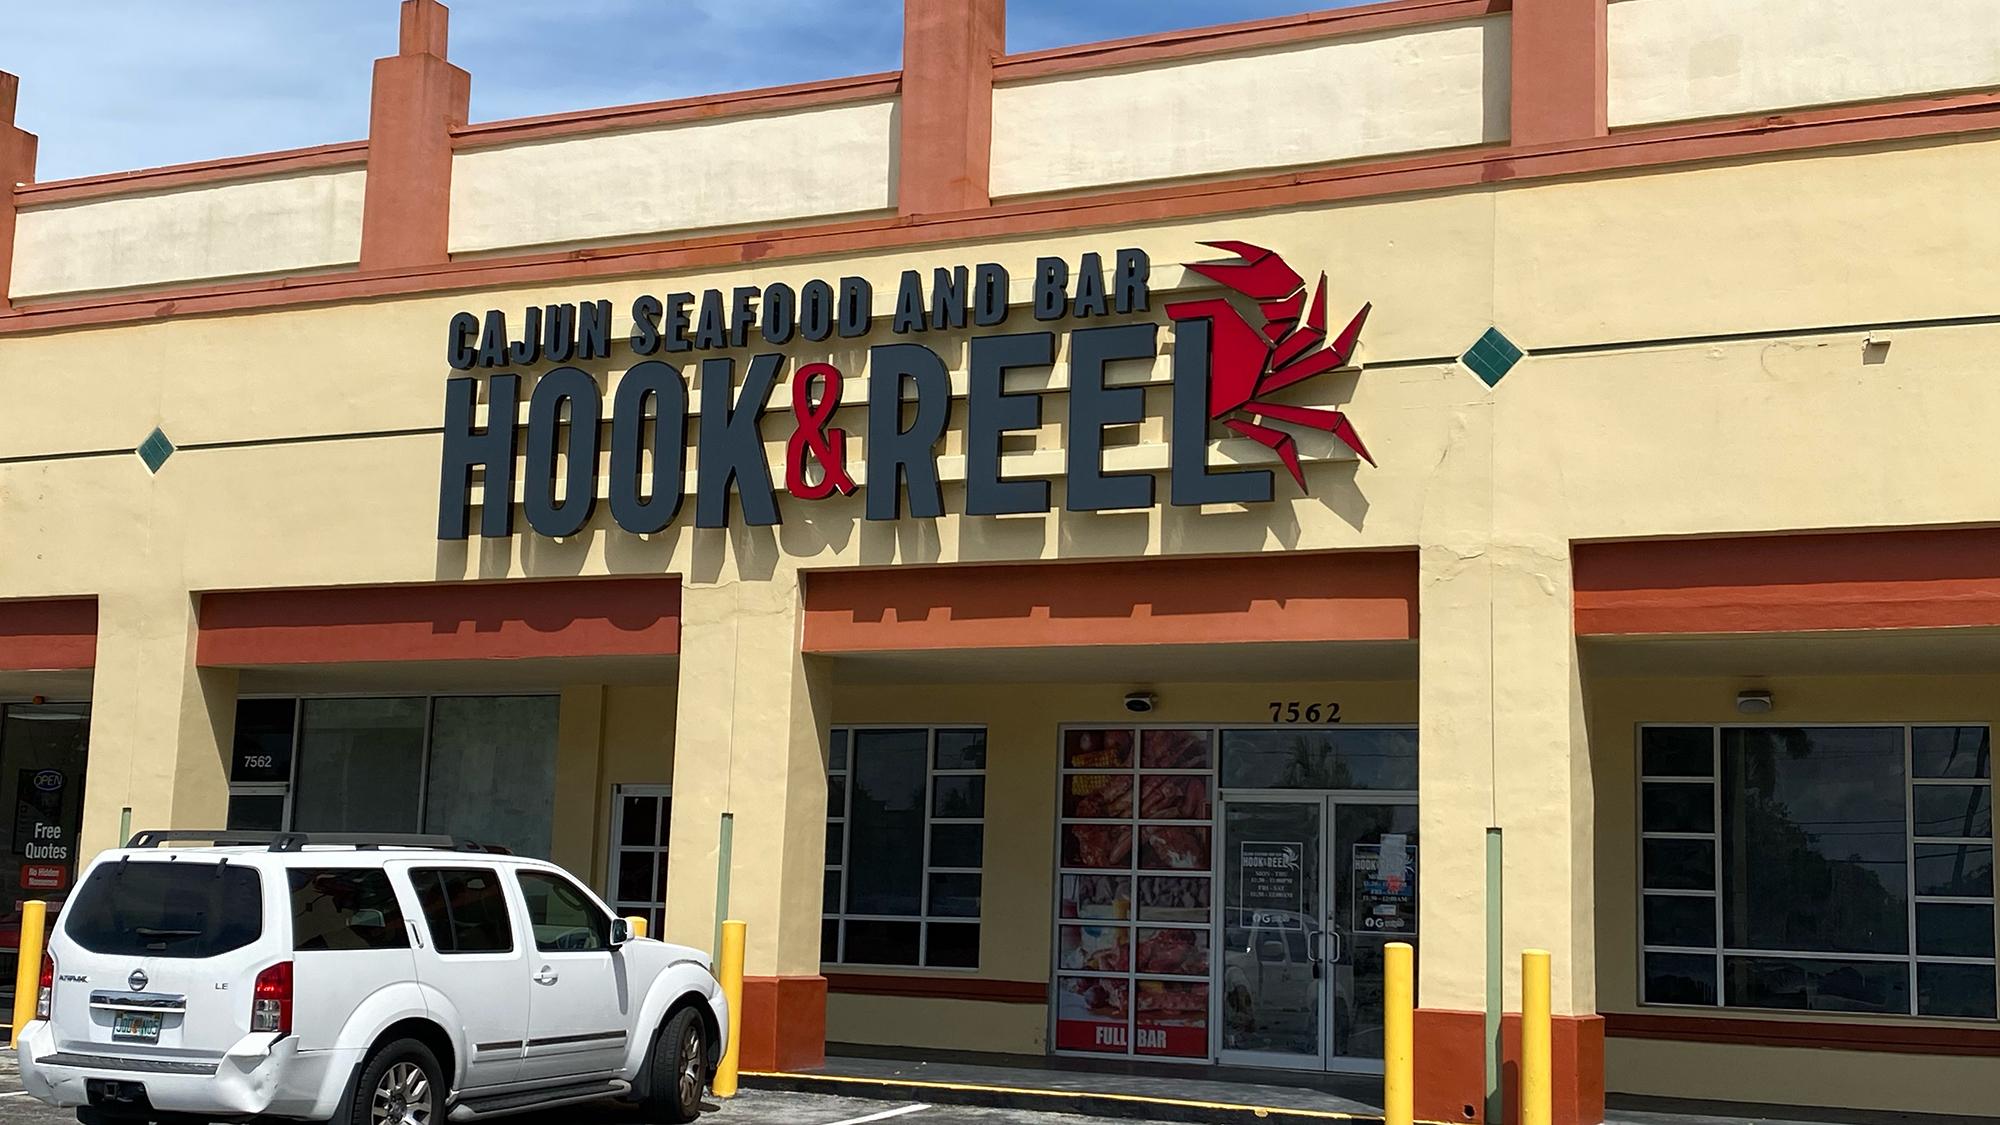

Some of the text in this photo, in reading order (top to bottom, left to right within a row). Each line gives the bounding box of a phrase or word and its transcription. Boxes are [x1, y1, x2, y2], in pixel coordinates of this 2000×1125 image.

[447, 247, 1150, 370] CAJUN SEAFOOD AND BAR
[1269, 702, 1341, 723] 7562
[244, 755, 272, 768] 7562
[34, 774, 63, 786] OPEN
[34, 822, 62, 839] Free
[25, 842, 67, 860] Quotes
[215, 982, 229, 990] LE
[1095, 1025, 1167, 1049] FULL BAR
